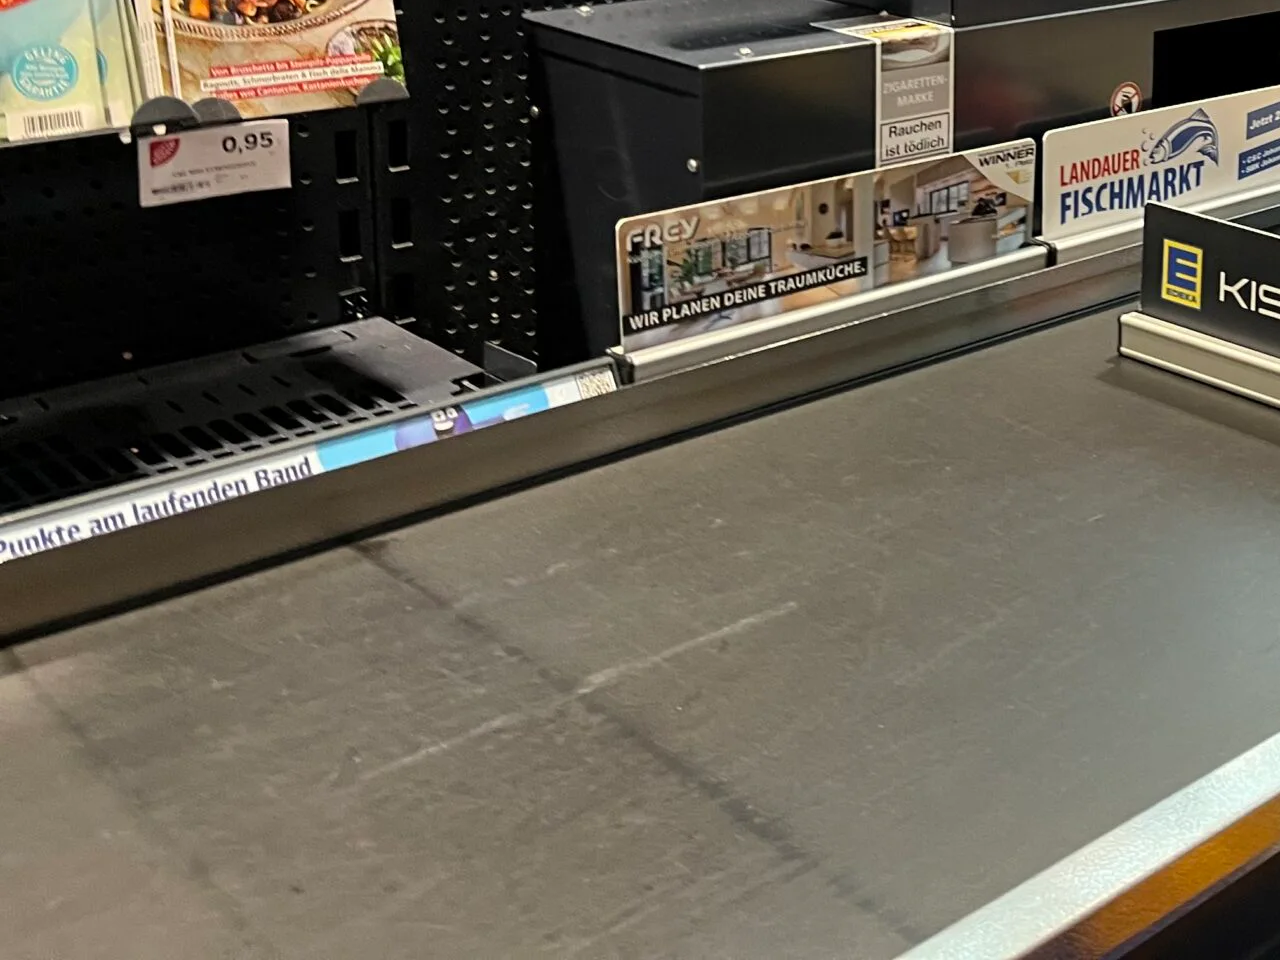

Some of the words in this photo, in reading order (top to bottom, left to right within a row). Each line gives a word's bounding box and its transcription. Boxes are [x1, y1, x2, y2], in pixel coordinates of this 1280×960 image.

[883, 74, 948, 95] ZIGARETTEN-
[897, 91, 934, 107] MARKE
[888, 119, 942, 138] Rauchen
[1249, 113, 1273, 130] Jetzt
[222, 131, 273, 154] 0,95
[885, 144, 901, 158] ist
[903, 136, 945, 156] tödlich
[979, 147, 1035, 167] WINNER
[1060, 149, 1140, 187] LANDAUER
[1060, 161, 1205, 225] FISCHMARKT
[626, 216, 699, 252] FREY
[628, 310, 660, 331] WIR
[662, 294, 721, 323] PLANEN
[724, 283, 767, 308] DEINE
[769, 259, 866, 296] TRAUMKÜCHE.
[89, 512, 128, 538] am
[132, 477, 249, 524] laufenden
[255, 456, 314, 490] Band
